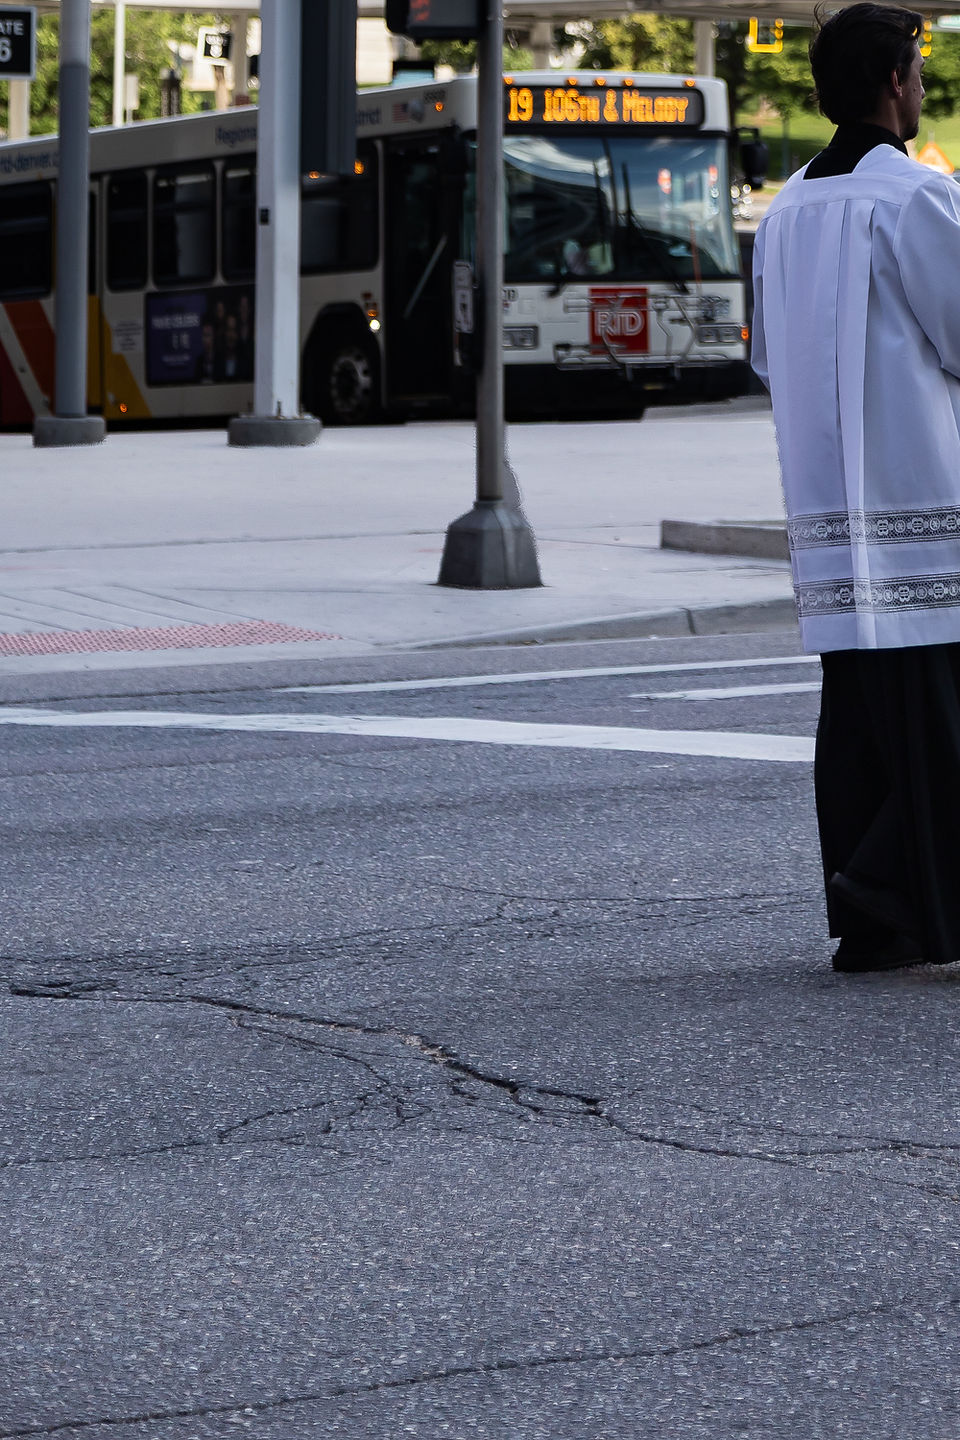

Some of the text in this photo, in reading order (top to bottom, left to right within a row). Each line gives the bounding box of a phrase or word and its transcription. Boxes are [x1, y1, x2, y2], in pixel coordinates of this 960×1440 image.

[508, 88, 533, 121] 19
[603, 89, 619, 122] &
[595, 311, 645, 336] RTD
